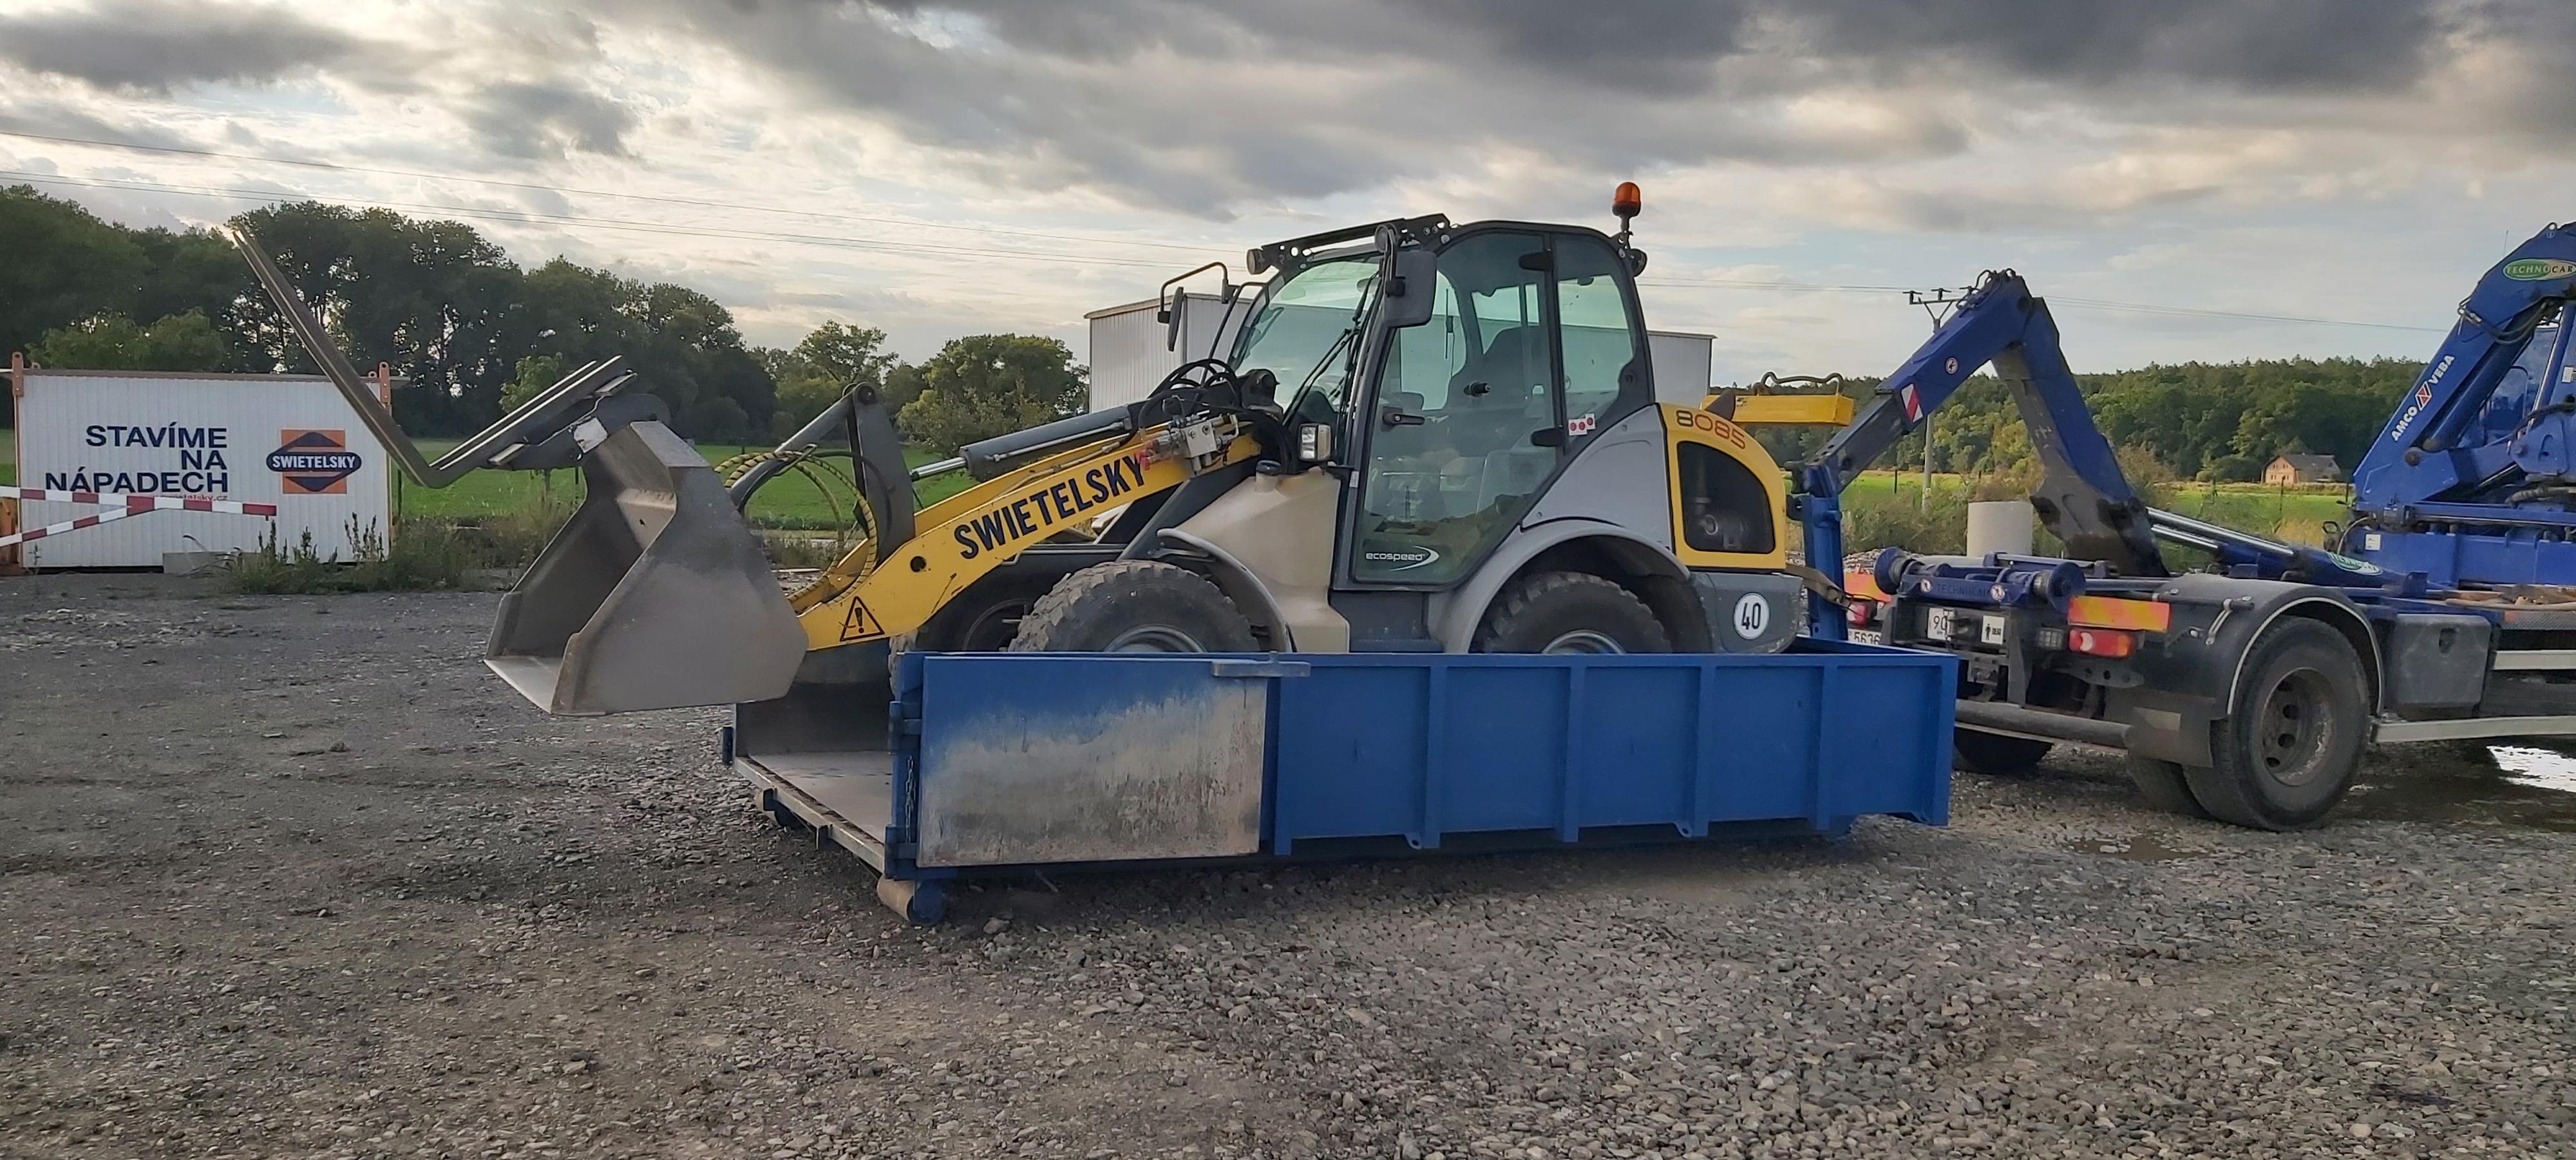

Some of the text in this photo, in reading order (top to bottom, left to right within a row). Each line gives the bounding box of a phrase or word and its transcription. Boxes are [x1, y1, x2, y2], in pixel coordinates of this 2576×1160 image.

[2506, 265, 2574, 274] TECHNOCAR
[2391, 355, 2455, 441] AMCO VEBA
[86, 422, 227, 448] STAVÍME
[1676, 410, 1746, 450] 8085
[180, 450, 228, 470] NA
[272, 455, 355, 469] SWIETELSKY
[45, 466, 228, 493] NÁPADECH
[954, 453, 1144, 560] SWIETELSKY
[1365, 553, 1423, 562] ecospeed
[1741, 602, 1761, 630] 40
